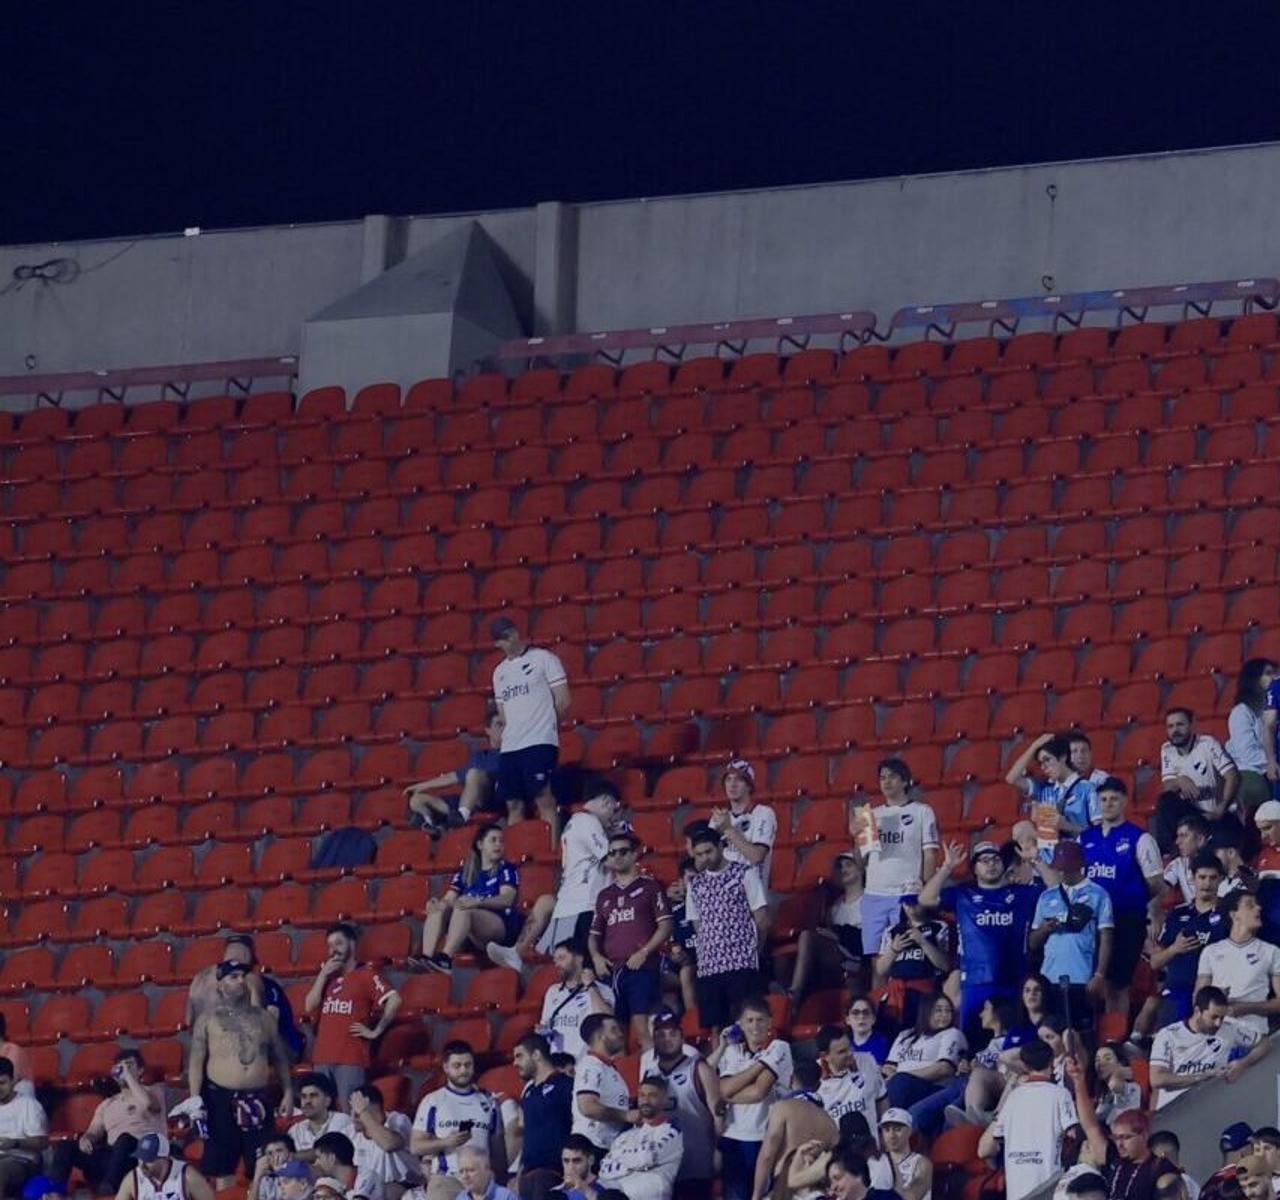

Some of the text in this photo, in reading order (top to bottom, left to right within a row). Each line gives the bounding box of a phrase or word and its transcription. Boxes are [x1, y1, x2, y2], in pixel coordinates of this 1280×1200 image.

[1087, 861, 1116, 880] antel
[976, 909, 1013, 927] antel
[322, 996, 354, 1015] antel
[1177, 1060, 1216, 1076] antel
